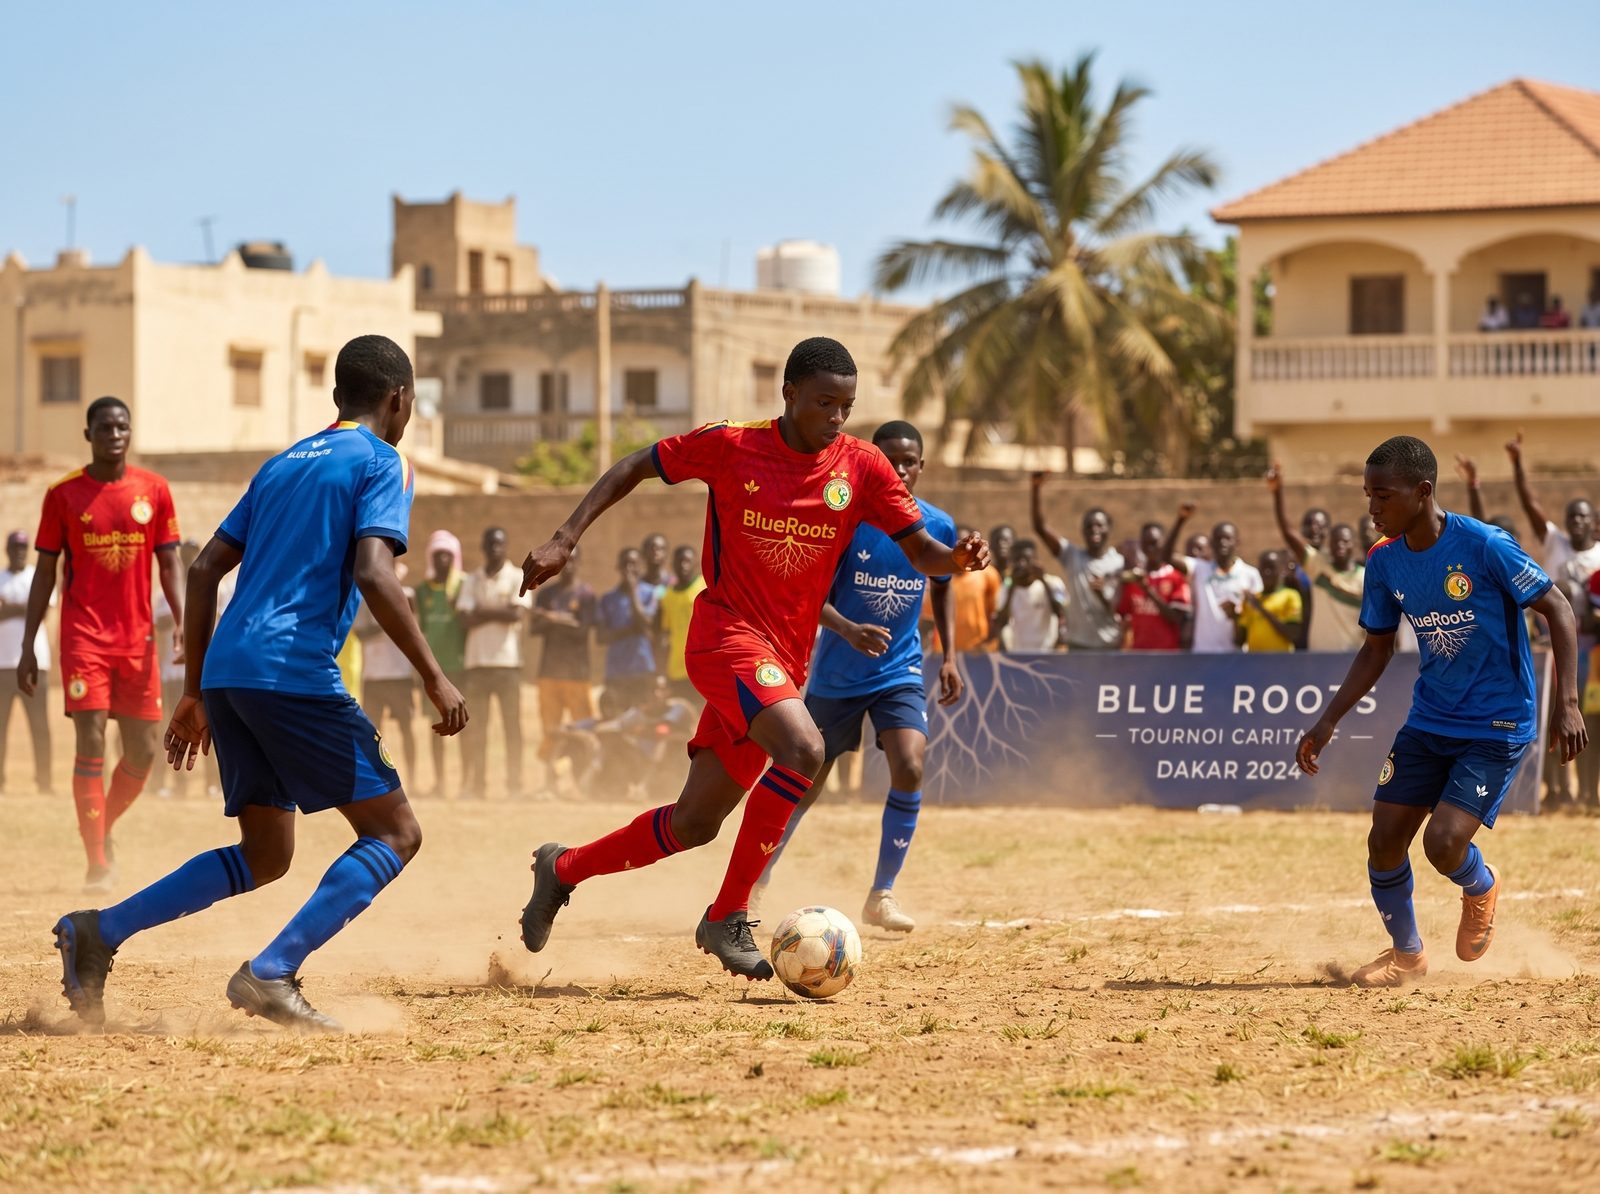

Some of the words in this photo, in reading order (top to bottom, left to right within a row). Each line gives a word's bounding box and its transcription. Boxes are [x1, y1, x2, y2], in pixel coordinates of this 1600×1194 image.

[742, 508, 837, 540] BlueRoots
[83, 531, 146, 546] BlueRoots
[854, 571, 924, 591] BlueRoots
[1408, 610, 1475, 628] lueRoots
[1097, 684, 1205, 714] BLUE
[1232, 684, 1377, 715] ROOS
[1128, 728, 1223, 745] TOURNOI
[1231, 728, 1340, 745] CARITAF
[1156, 760, 1239, 780] DAKAR
[1245, 761, 1302, 780] 2024
